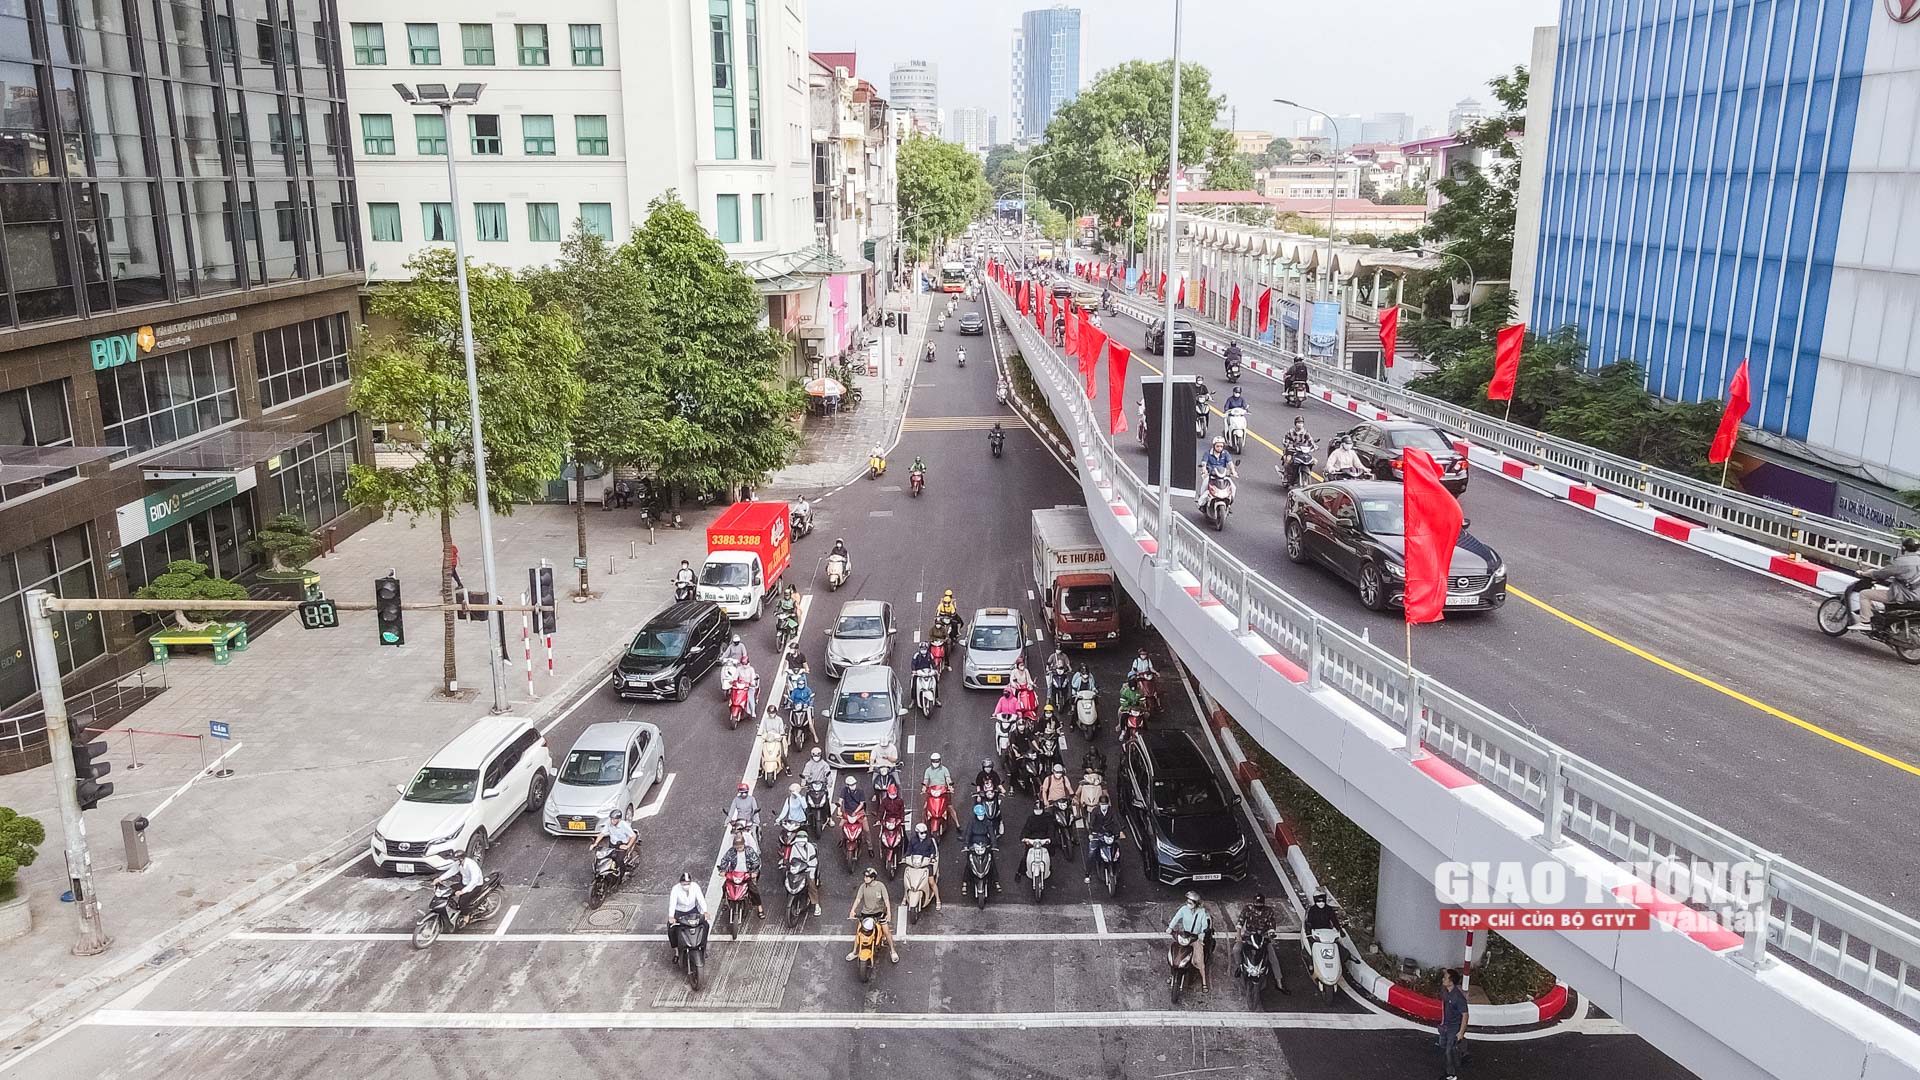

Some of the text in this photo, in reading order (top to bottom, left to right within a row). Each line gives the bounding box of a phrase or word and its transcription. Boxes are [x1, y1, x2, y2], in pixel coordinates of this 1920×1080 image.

[90, 332, 138, 370] BIDV
[150, 498, 172, 522] BIDV
[711, 534, 761, 545] 3388.3388
[1056, 553, 1068, 564] XE
[1070, 551, 1087, 563] THƯ
